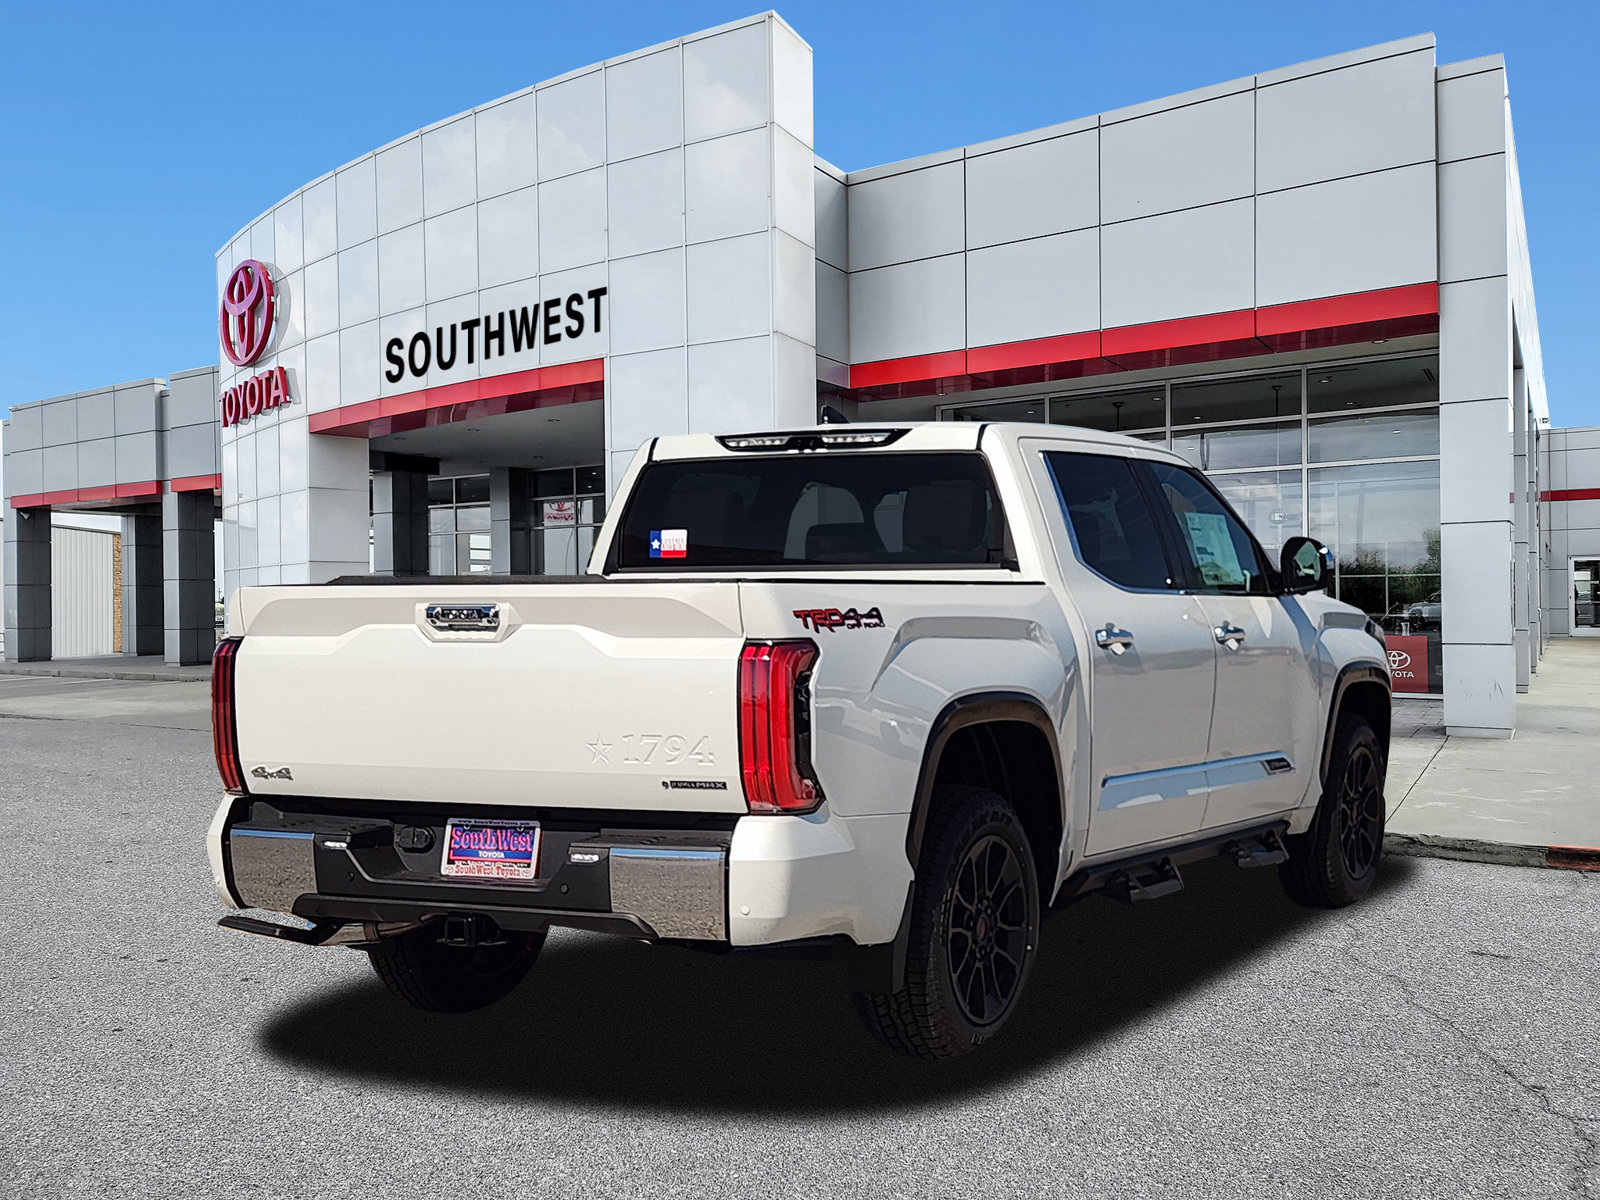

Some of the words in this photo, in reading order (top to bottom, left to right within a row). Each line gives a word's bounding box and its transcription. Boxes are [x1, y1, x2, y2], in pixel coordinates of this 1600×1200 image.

[385, 286, 607, 383] SOUTHWEST
[218, 366, 291, 427] TOYOTA
[793, 608, 845, 633] TRD
[621, 734, 715, 766] 1794
[478, 850, 505, 859] TOYOTA
[496, 865, 521, 879] Toyota
